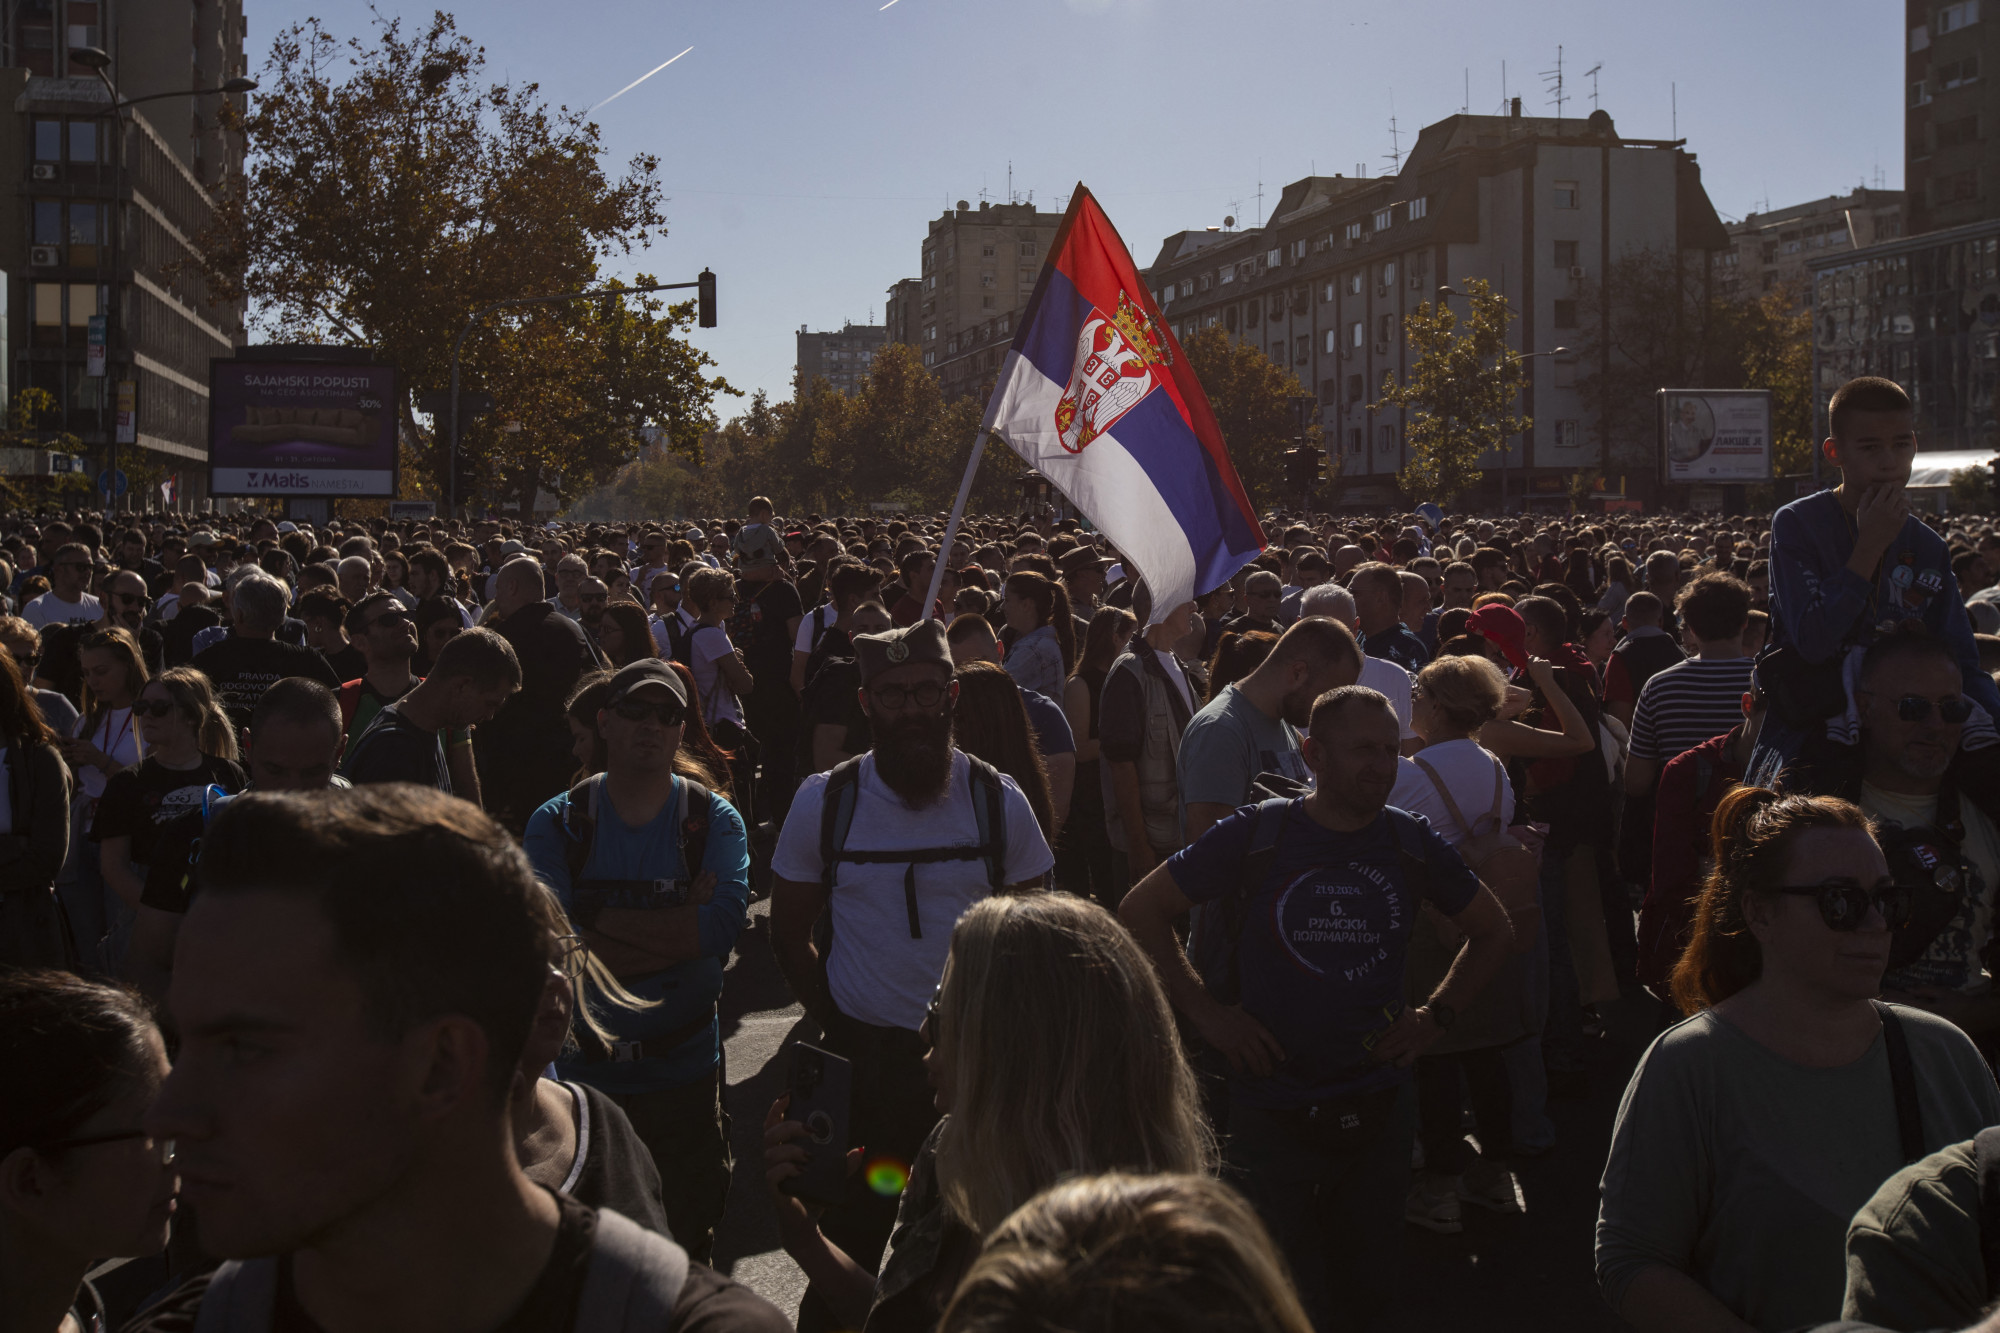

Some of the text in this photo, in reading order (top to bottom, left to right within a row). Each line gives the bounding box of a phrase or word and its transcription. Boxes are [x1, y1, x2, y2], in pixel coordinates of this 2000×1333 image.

[244, 374, 370, 388] SAJAMSKI POPUSTI
[260, 388, 273, 396] NA
[300, 388, 353, 397] ASORTIMAN
[1715, 436, 1750, 446] ЛАКШЕ
[262, 472, 364, 490] Matis NAMEŠTAJ
[238, 672, 281, 681] PRAVDA
[1315, 884, 1363, 896] 21.9.2024.
[1308, 917, 1367, 930] РУМСКИ
[1293, 930, 1380, 944] ПОЛУМАРАТОН
